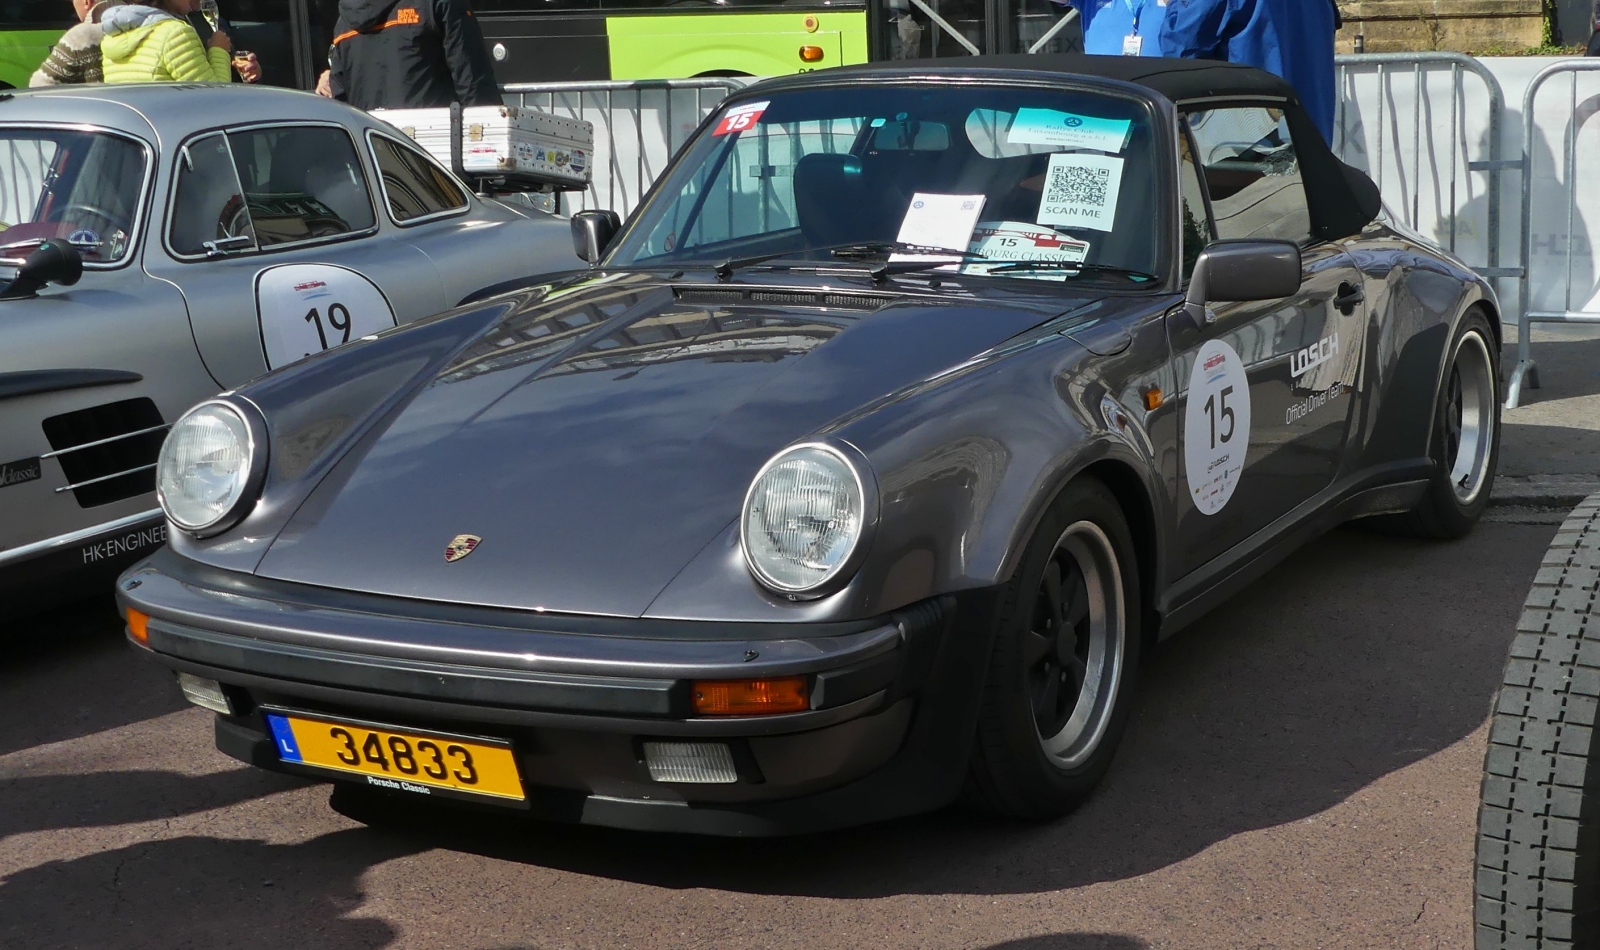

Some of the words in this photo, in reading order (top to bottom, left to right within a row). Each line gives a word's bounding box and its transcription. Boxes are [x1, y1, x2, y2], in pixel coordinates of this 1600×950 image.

[726, 112, 755, 131] 15
[1045, 124, 1072, 133] Rallye
[1028, 127, 1079, 138] Luxembourg
[1045, 206, 1078, 216] SCAN
[1081, 208, 1102, 219] ME
[1000, 238, 1019, 248] 15
[1021, 250, 1071, 262] CLASSIC
[304, 302, 351, 350] 19
[1290, 332, 1339, 378] LOSCH
[1285, 398, 1308, 425] Official
[1308, 392, 1328, 412] Driver
[1327, 383, 1344, 401] Team
[1203, 385, 1235, 450] 15
[281, 739, 294, 753] L
[329, 727, 479, 785] 34833
[367, 776, 401, 790] Porsche
[401, 781, 431, 795] Classic
